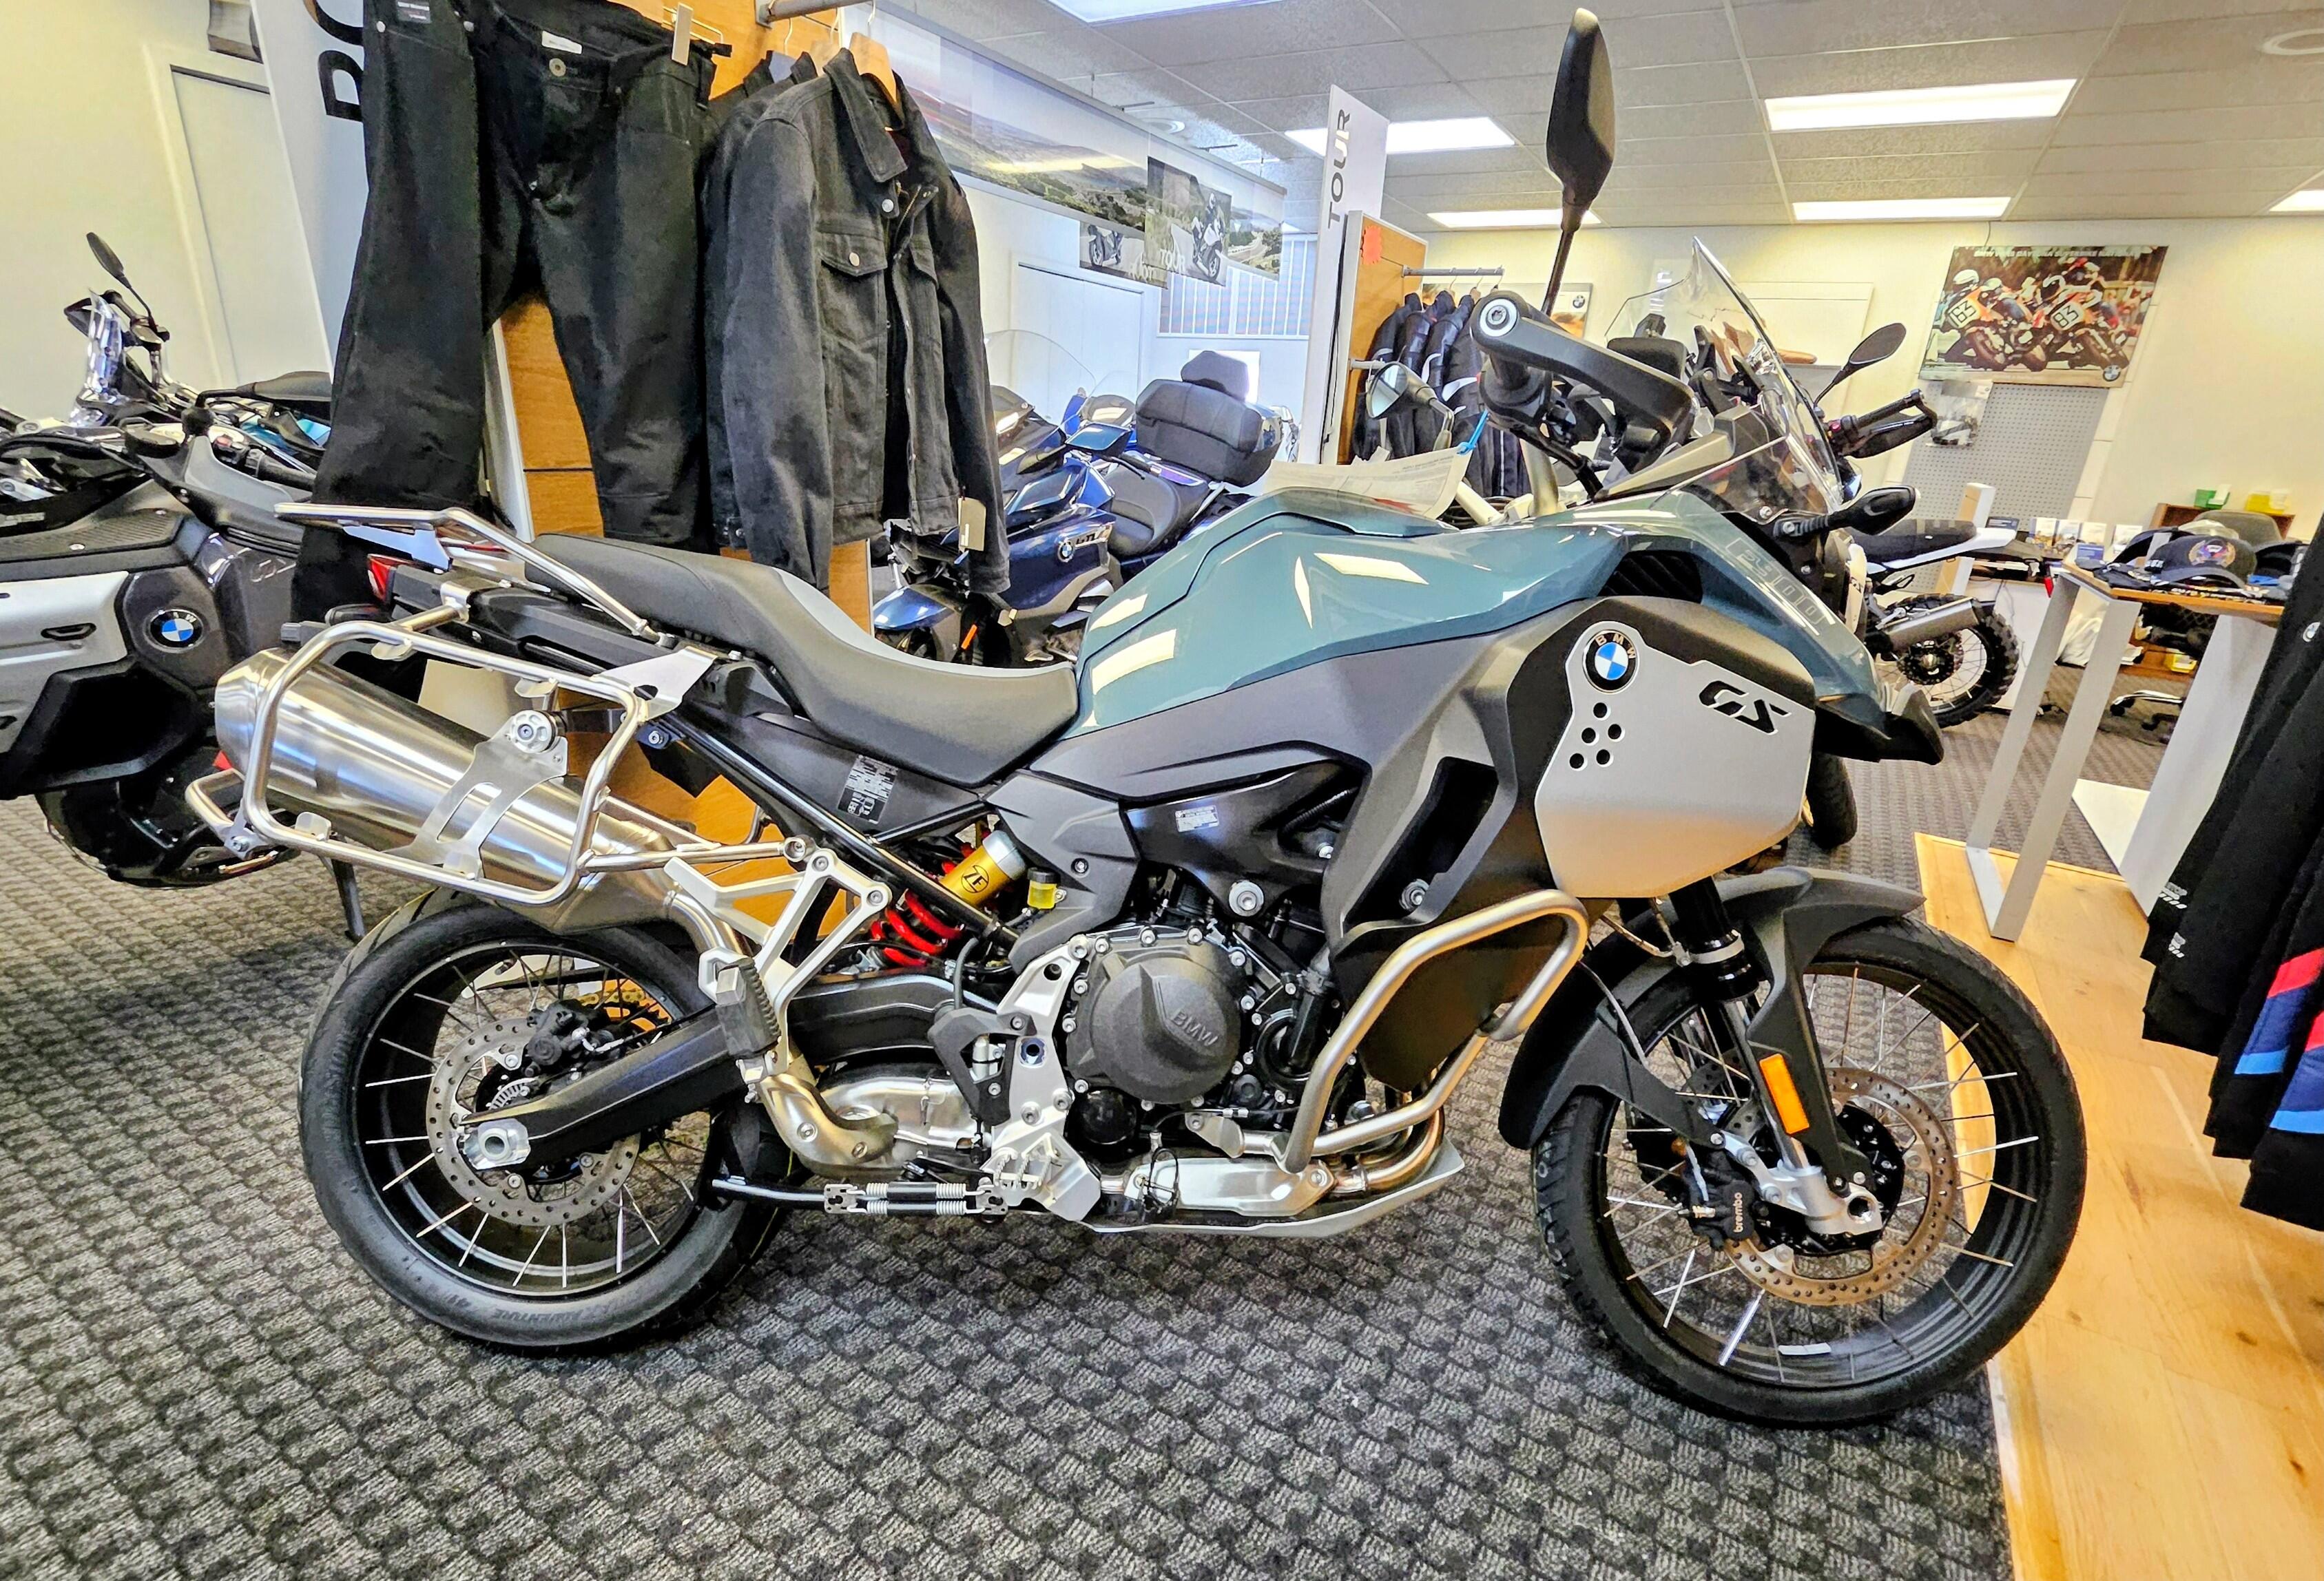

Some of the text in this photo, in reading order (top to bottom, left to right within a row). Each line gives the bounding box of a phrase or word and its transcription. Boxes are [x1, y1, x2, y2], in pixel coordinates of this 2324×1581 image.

[1328, 109, 1351, 229] TOUR
[2053, 304, 2079, 328] 83
[1595, 633, 1637, 659] BMW
[1699, 680, 1789, 734] GS
[962, 865, 989, 893] ZF
[1172, 1009, 1218, 1046] BMW
[1732, 1192, 1744, 1233] brembo
